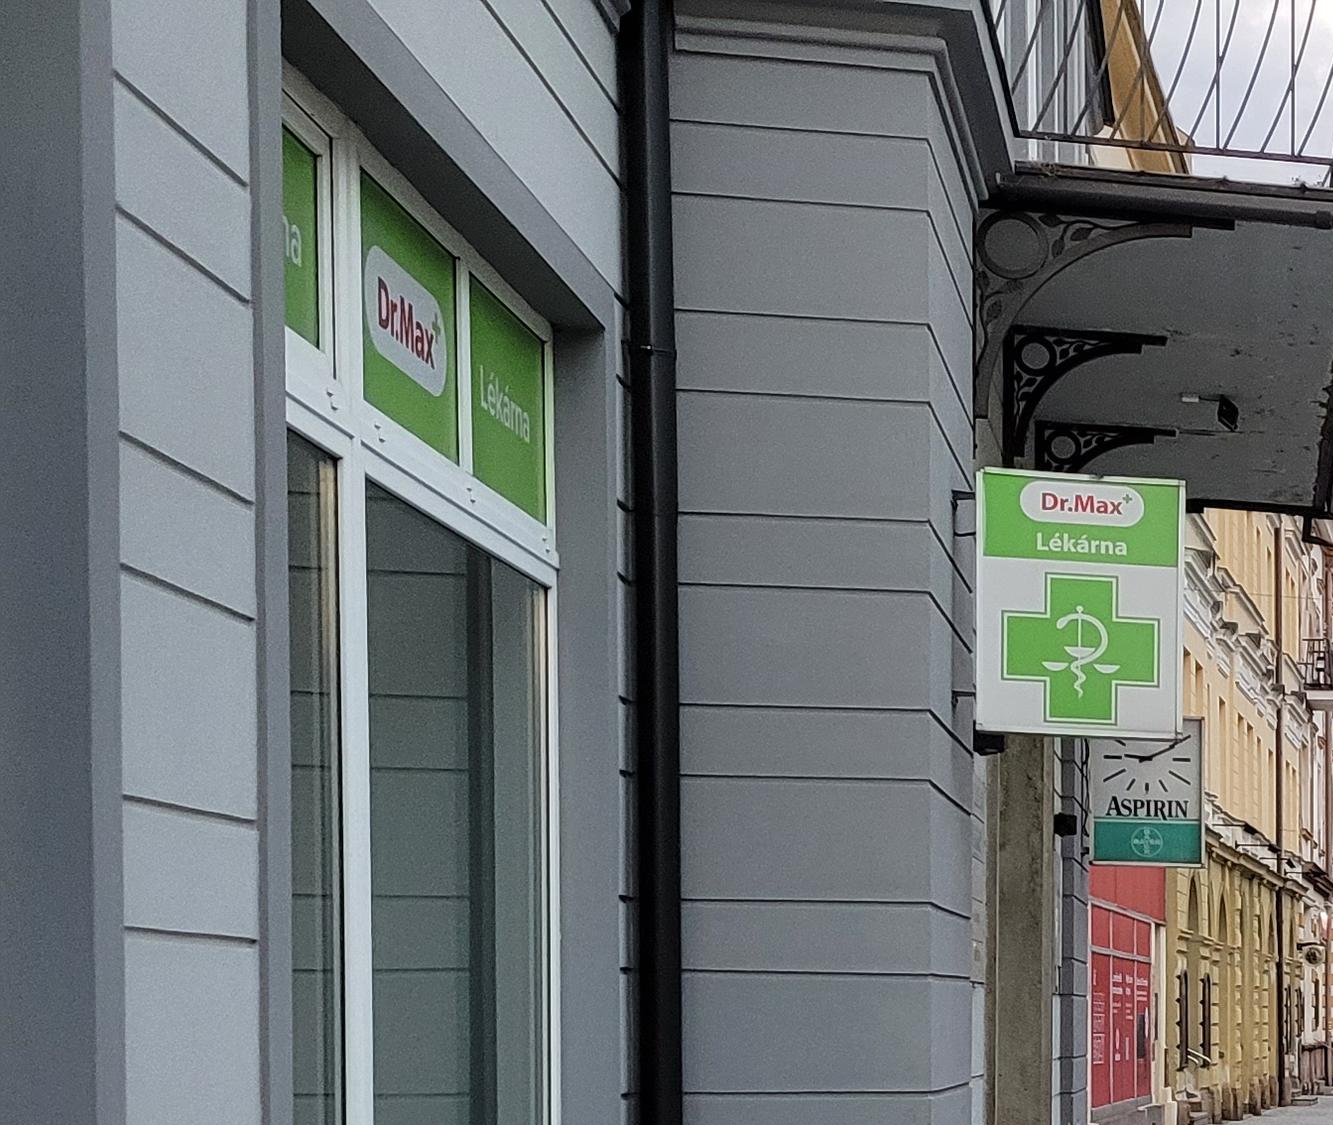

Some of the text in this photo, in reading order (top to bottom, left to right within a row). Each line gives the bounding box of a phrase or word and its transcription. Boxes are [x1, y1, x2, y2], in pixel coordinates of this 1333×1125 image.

[377, 275, 436, 371] Dr.Max
[479, 364, 531, 444] Lékárna
[1041, 492, 1123, 515] Dr.Max
[1036, 532, 1128, 556] Lékárna
[1105, 796, 1189, 821] ASPIRIN
